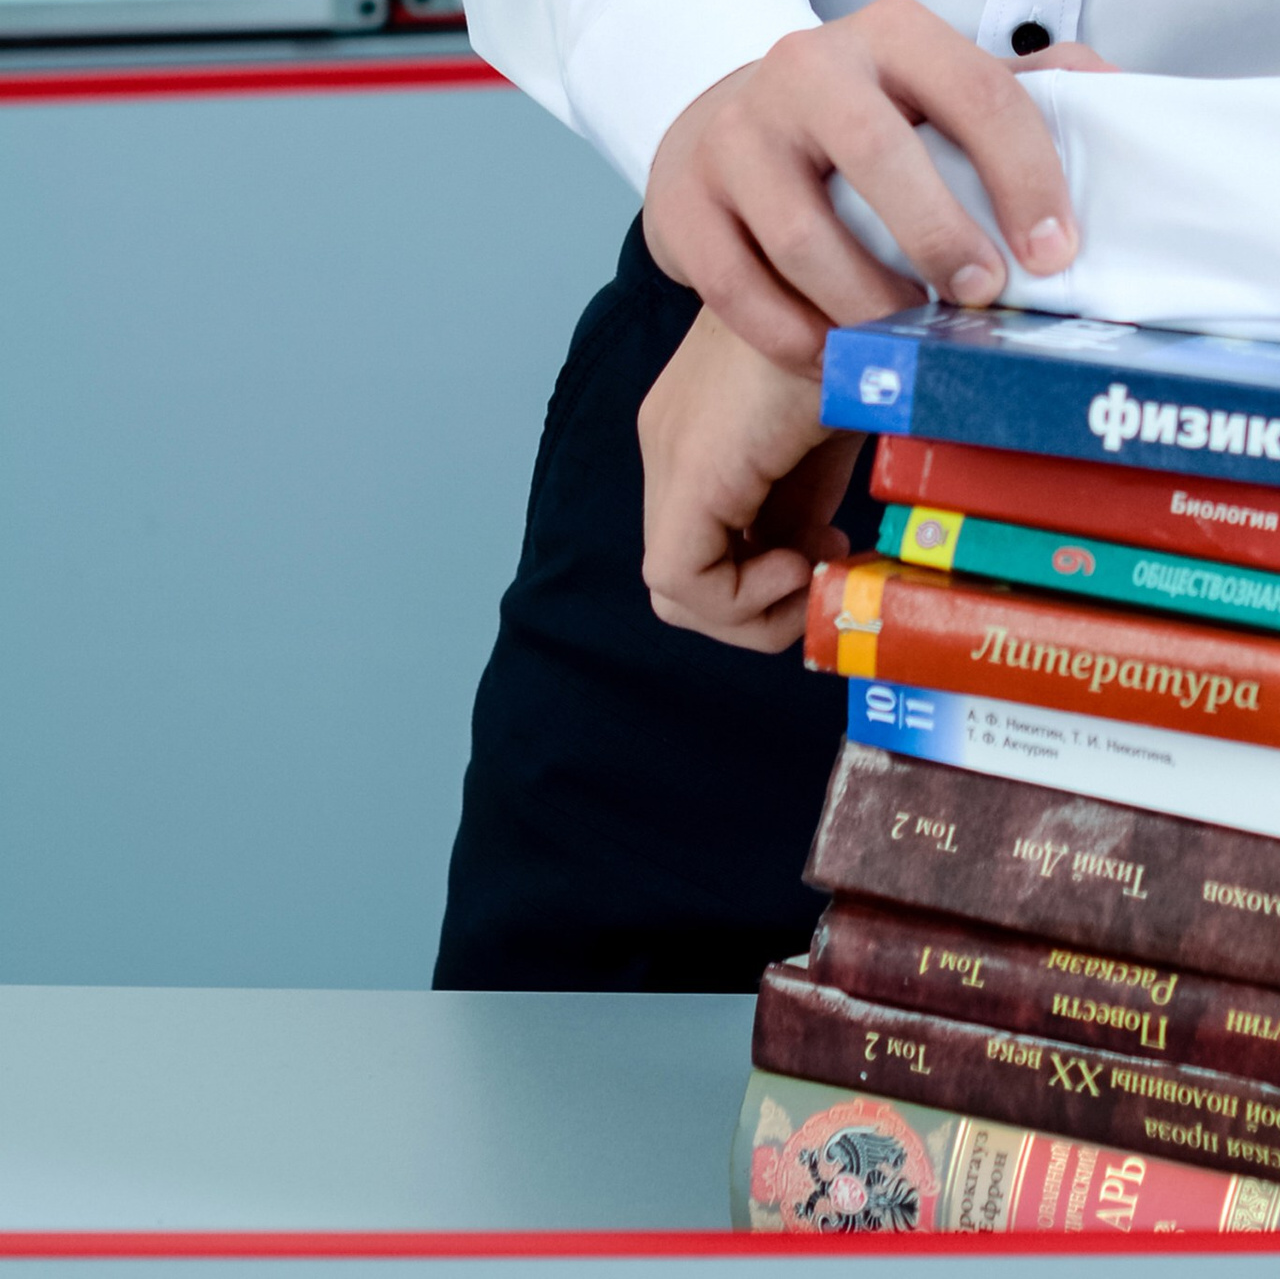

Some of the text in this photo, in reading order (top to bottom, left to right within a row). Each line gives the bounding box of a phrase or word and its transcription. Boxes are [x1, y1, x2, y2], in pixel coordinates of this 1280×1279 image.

[1170, 490, 1279, 531] Биология
[1052, 546, 1096, 577] 9
[970, 625, 1260, 713] Литература
[866, 686, 897, 723] 10
[905, 699, 934, 730] 11
[1003, 737, 1059, 761] Акчурин
[891, 811, 957, 853] Том 2
[1012, 837, 1147, 899] Тихий Дон
[919, 946, 984, 988] Том 1
[1047, 949, 1178, 1005] Рассказы
[1052, 994, 1168, 1049] Повести
[865, 1032, 931, 1075] Том 2
[987, 1039, 1042, 1070] века
[1111, 1067, 1238, 1118] половины
[1144, 1117, 1218, 1153] проза
[955, 1131, 988, 1233] рокгауз
